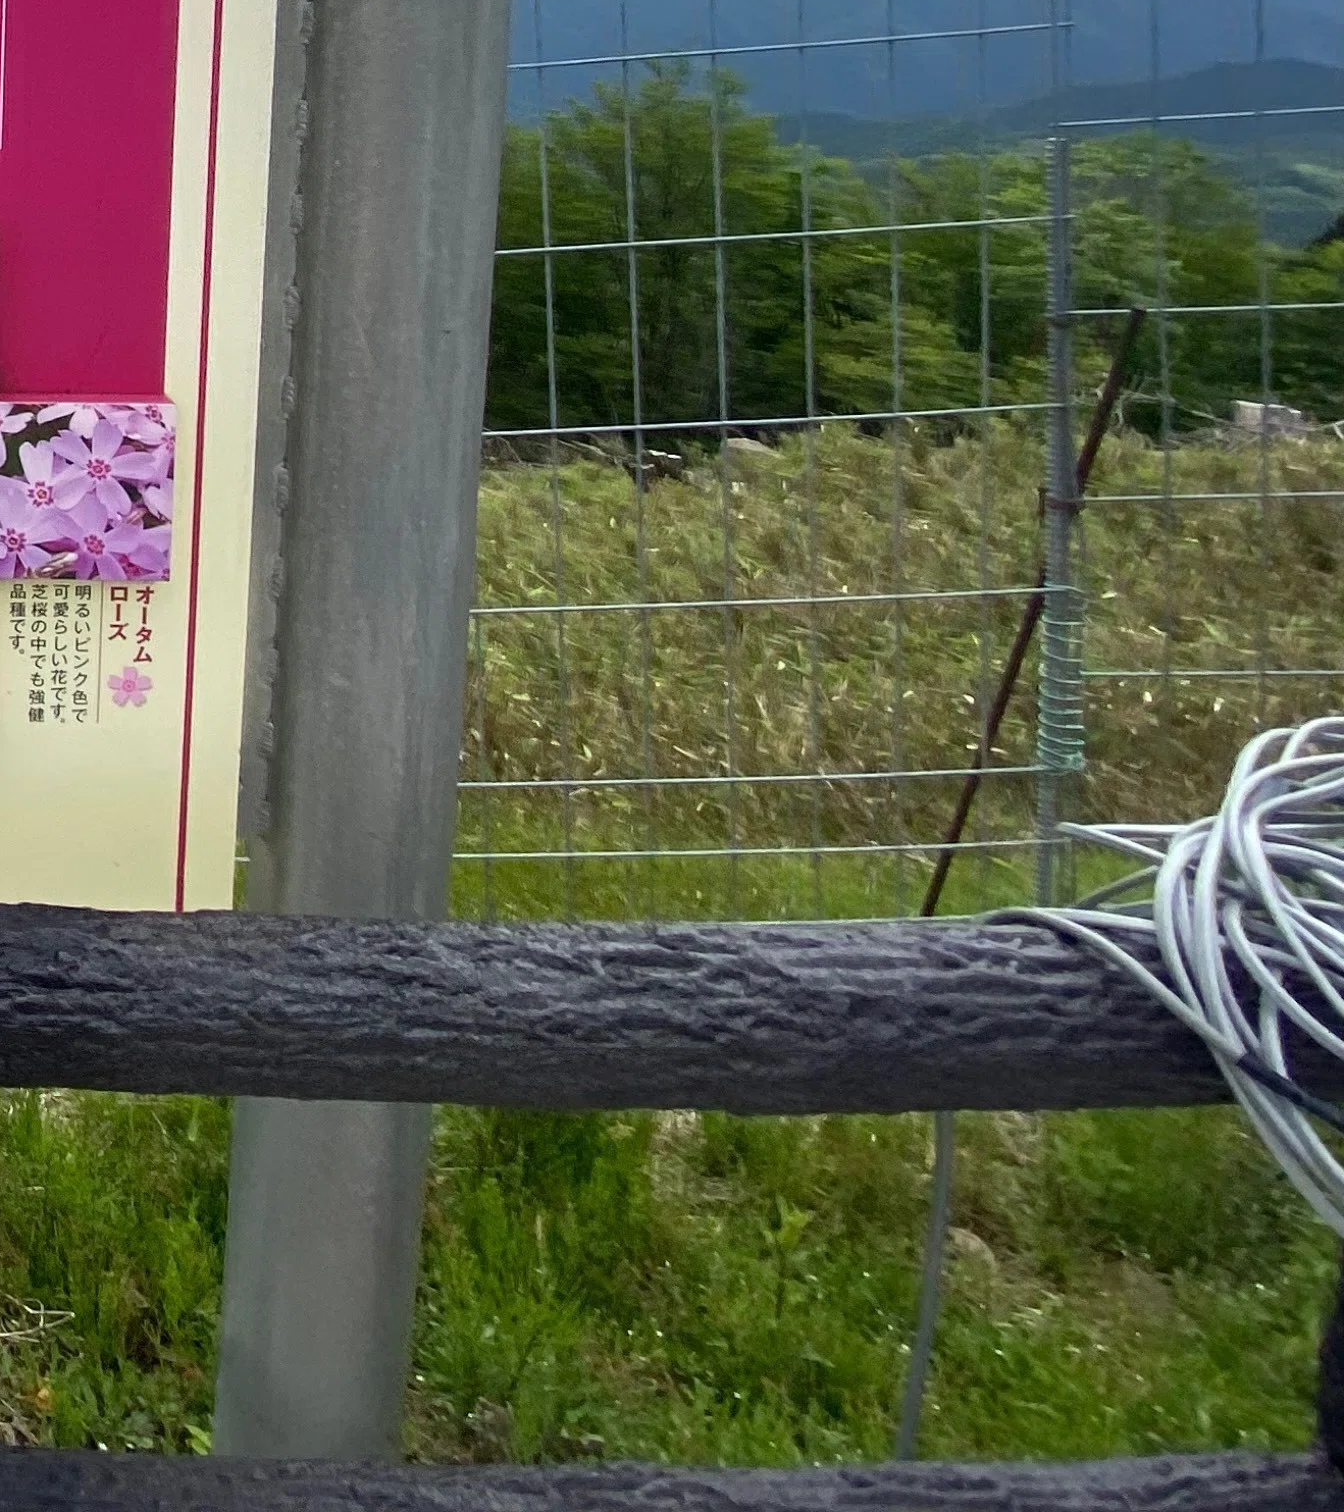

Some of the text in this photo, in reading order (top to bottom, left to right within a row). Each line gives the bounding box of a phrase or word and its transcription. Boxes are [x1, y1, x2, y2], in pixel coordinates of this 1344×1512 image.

[8, 583, 27, 655] 品種です。
[28, 584, 48, 723] 芝桜の中でも強健
[50, 584, 71, 724] 可愛らしい花です。
[72, 584, 92, 724] 明るいピンク色で
[108, 586, 129, 641] ローズ
[132, 586, 155, 663] オータム
